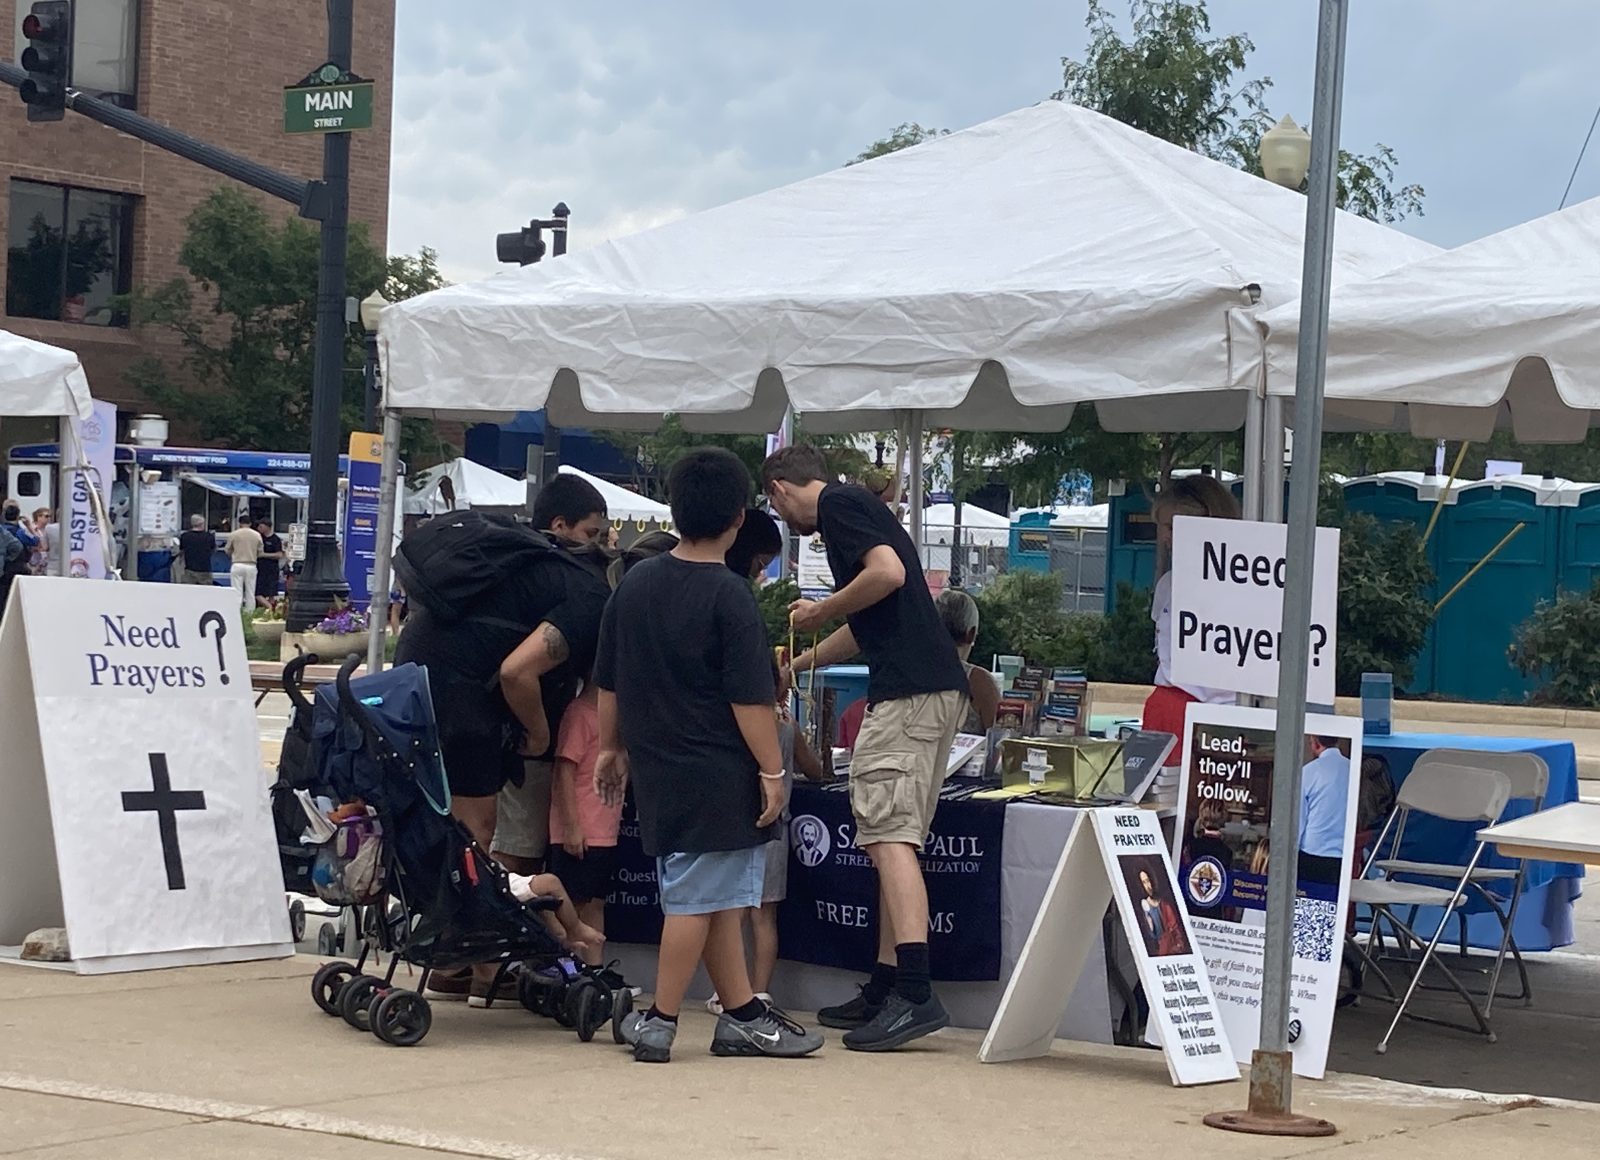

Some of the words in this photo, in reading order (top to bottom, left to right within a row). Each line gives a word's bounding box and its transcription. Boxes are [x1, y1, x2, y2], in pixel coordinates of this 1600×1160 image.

[305, 90, 353, 112] MAIN
[314, 117, 343, 128] STREET
[72, 461, 89, 502] GAT
[70, 508, 87, 552] EAST
[100, 614, 180, 649] Need
[86, 653, 206, 694] Prayers
[1201, 733, 1247, 757] Lead,
[1199, 757, 1251, 781] they'll
[1197, 781, 1253, 804] follow.
[1114, 815, 1140, 827] NEED
[919, 831, 984, 857] PAUL
[1113, 833, 1156, 847] PRAYER?
[619, 868, 657, 884] Quest
[620, 892, 648, 905] True
[816, 900, 868, 927] FREE
[1209, 923, 1233, 934] Knights
[1247, 929, 1258, 937] QR
